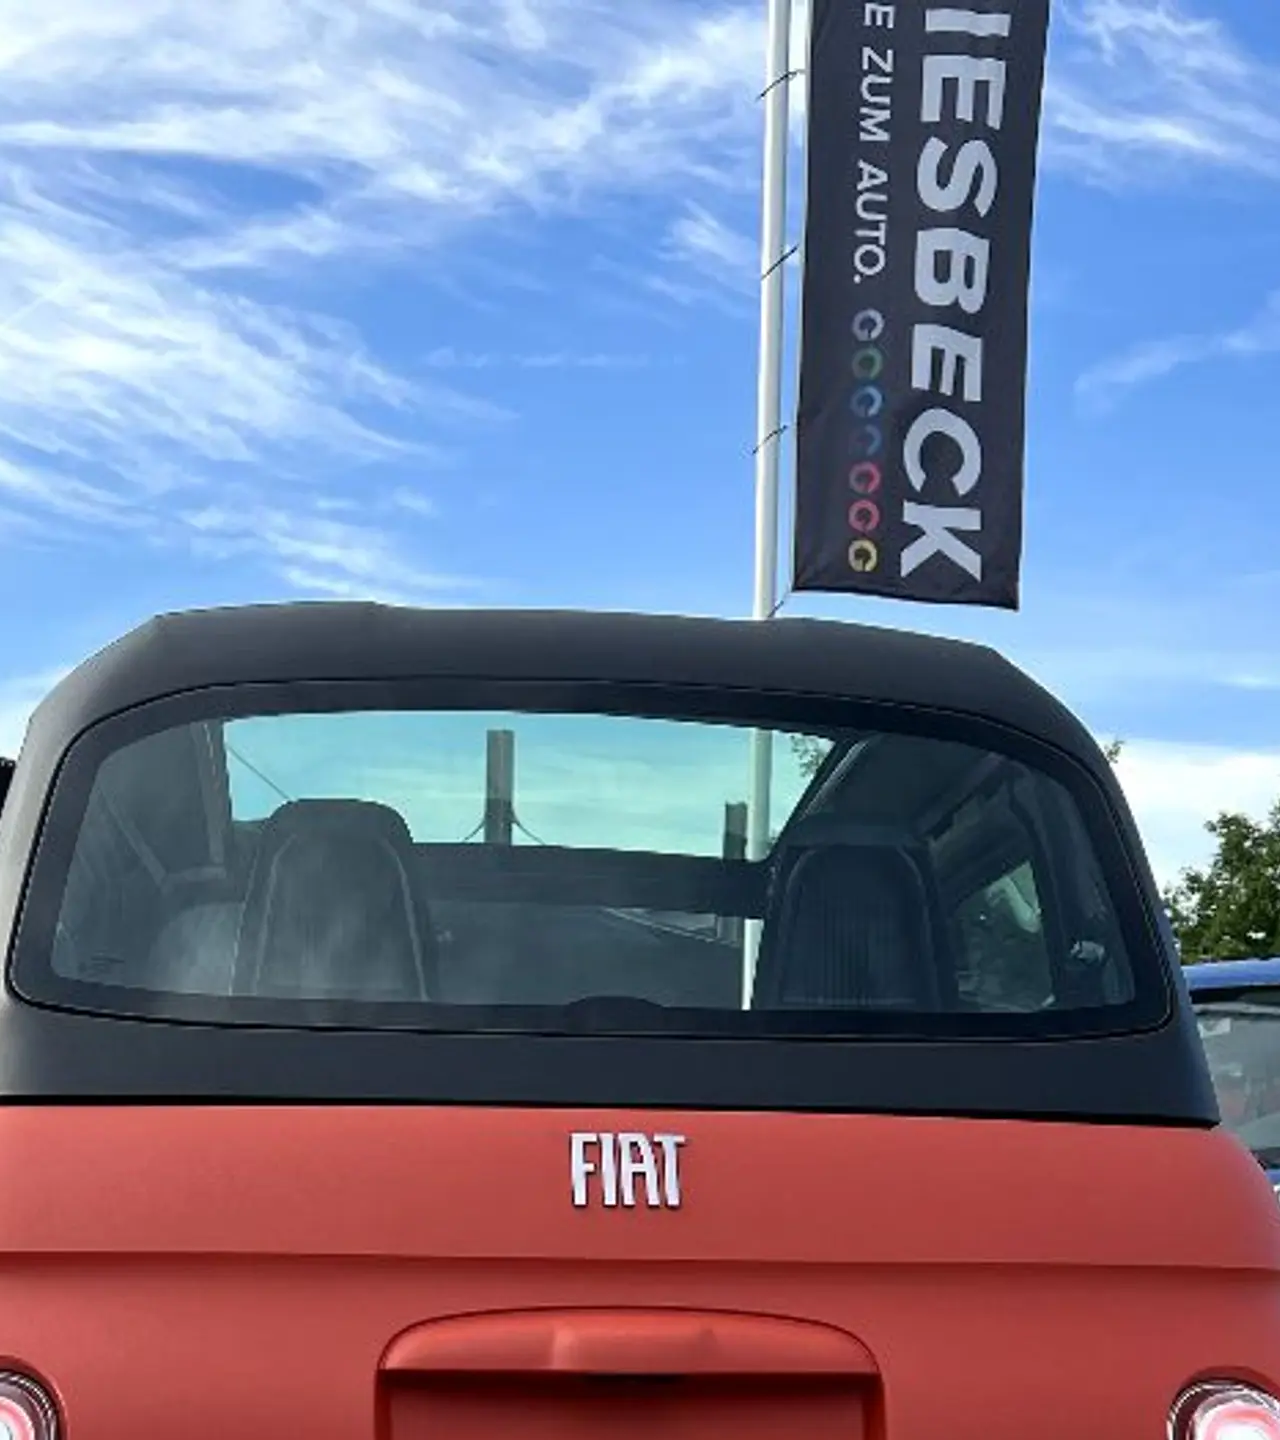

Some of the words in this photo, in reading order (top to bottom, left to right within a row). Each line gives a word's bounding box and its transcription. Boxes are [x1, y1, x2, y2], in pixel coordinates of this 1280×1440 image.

[863, 2, 895, 29] E
[859, 47, 894, 143] ZUM
[853, 160, 888, 284] AUTO.
[900, 8, 1011, 583] IESBECK
[571, 1132, 686, 1206] FIAT
